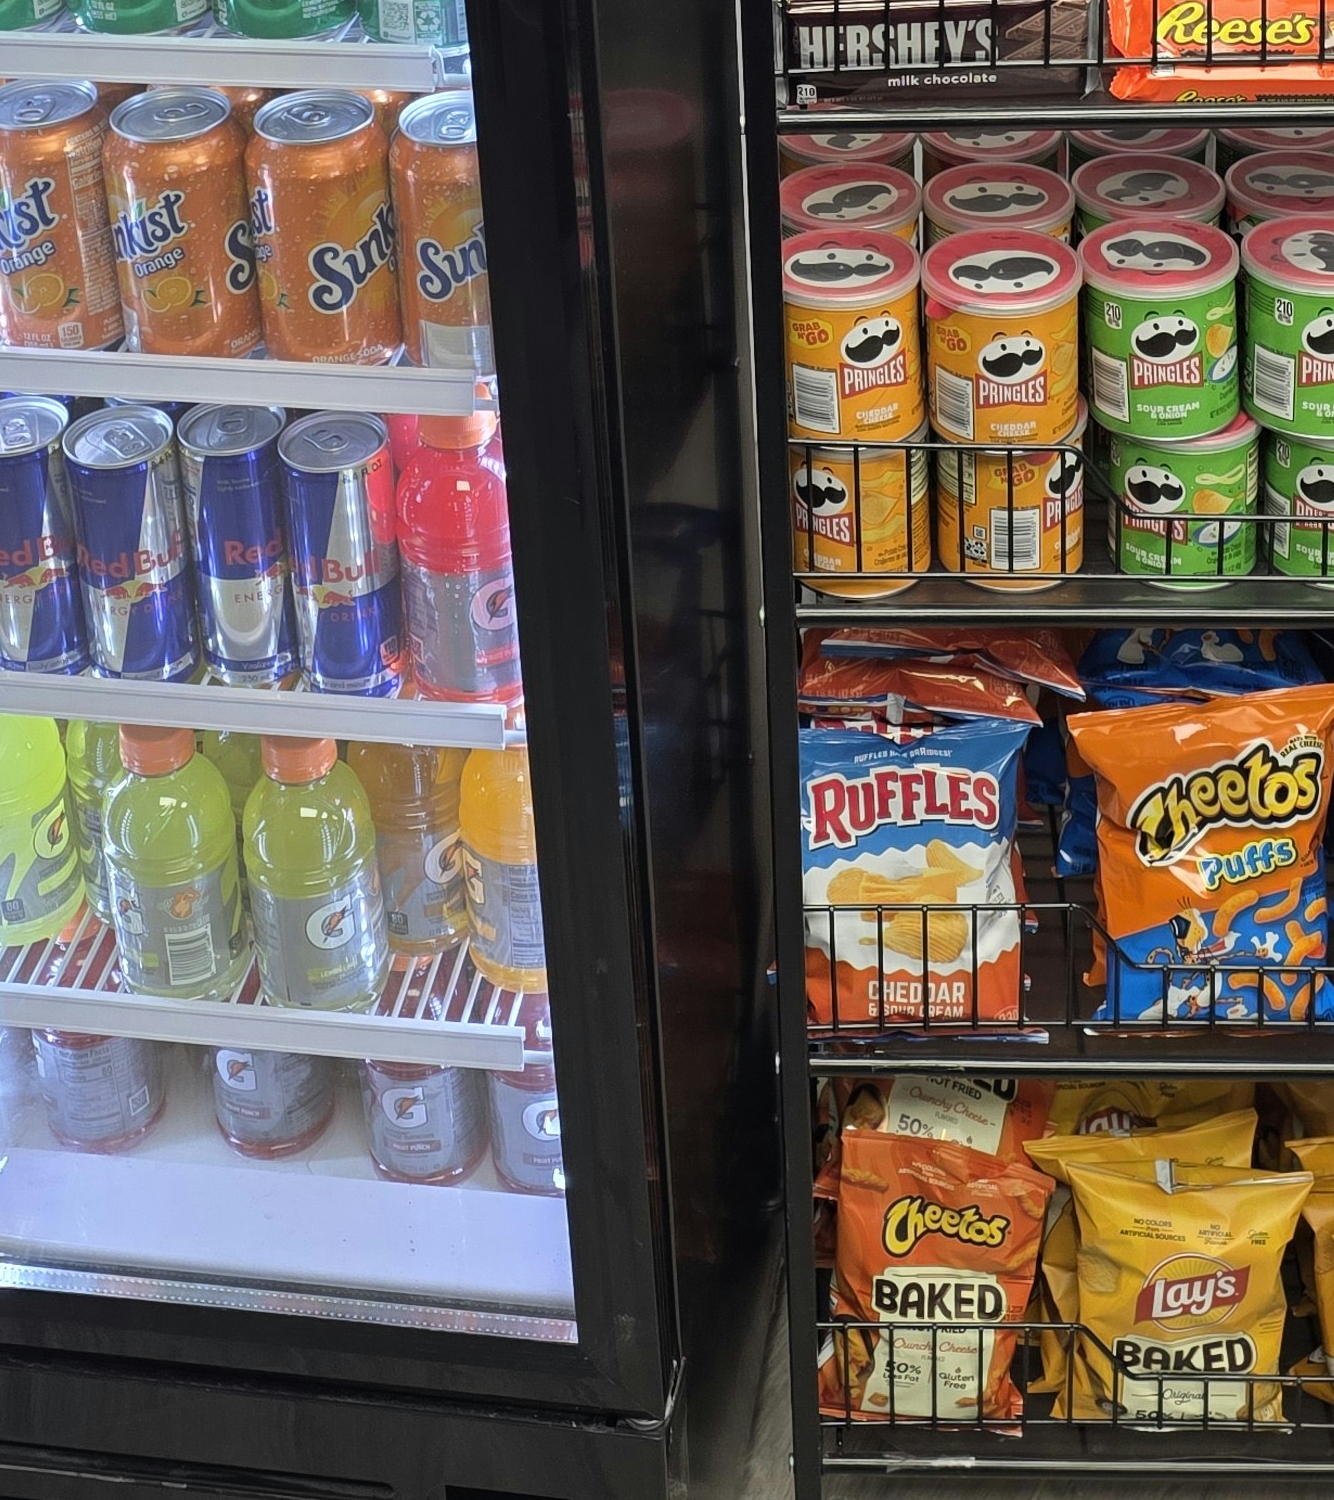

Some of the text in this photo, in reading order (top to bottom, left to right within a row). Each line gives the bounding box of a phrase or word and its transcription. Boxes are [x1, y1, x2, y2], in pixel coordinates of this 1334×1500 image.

[1156, 1, 1316, 46] Reese's
[798, 18, 1000, 69] HERSHEY'S
[888, 73, 998, 87] milk chocolate
[1, 240, 55, 275] Orange
[134, 247, 184, 277] Orange
[1276, 299, 1293, 315] 210
[792, 322, 821, 333] GRAB
[843, 355, 905, 395] PRINGLES
[1134, 359, 1200, 385] PRINGLES
[979, 376, 1045, 404] PRINGLES
[1136, 401, 1200, 413] SOUR CREAM
[1302, 402, 1330, 411] SOUR
[322, 551, 380, 583] Bull
[811, 769, 997, 843] RUFFLES
[1131, 743, 1321, 860] Cheetos
[1199, 841, 1294, 886] Puffs
[951, 1081, 982, 1100] FRIED
[909, 1086, 988, 1127] Crunchy Cheese
[898, 1114, 934, 1138] 50%
[884, 1197, 1008, 1256] Cheetos
[1120, 1228, 1186, 1242] ARTIFICIAL SOURCES
[1198, 1229, 1233, 1238] ARTIFICIAL
[875, 1278, 1003, 1320] BAKED
[1152, 1271, 1236, 1318] Lay's
[939, 1341, 978, 1354] Cheese
[1116, 1337, 1253, 1373] BAKED
[903, 1373, 920, 1382] Fat
[939, 1372, 975, 1382] Gluten
[944, 1380, 967, 1390] Free
